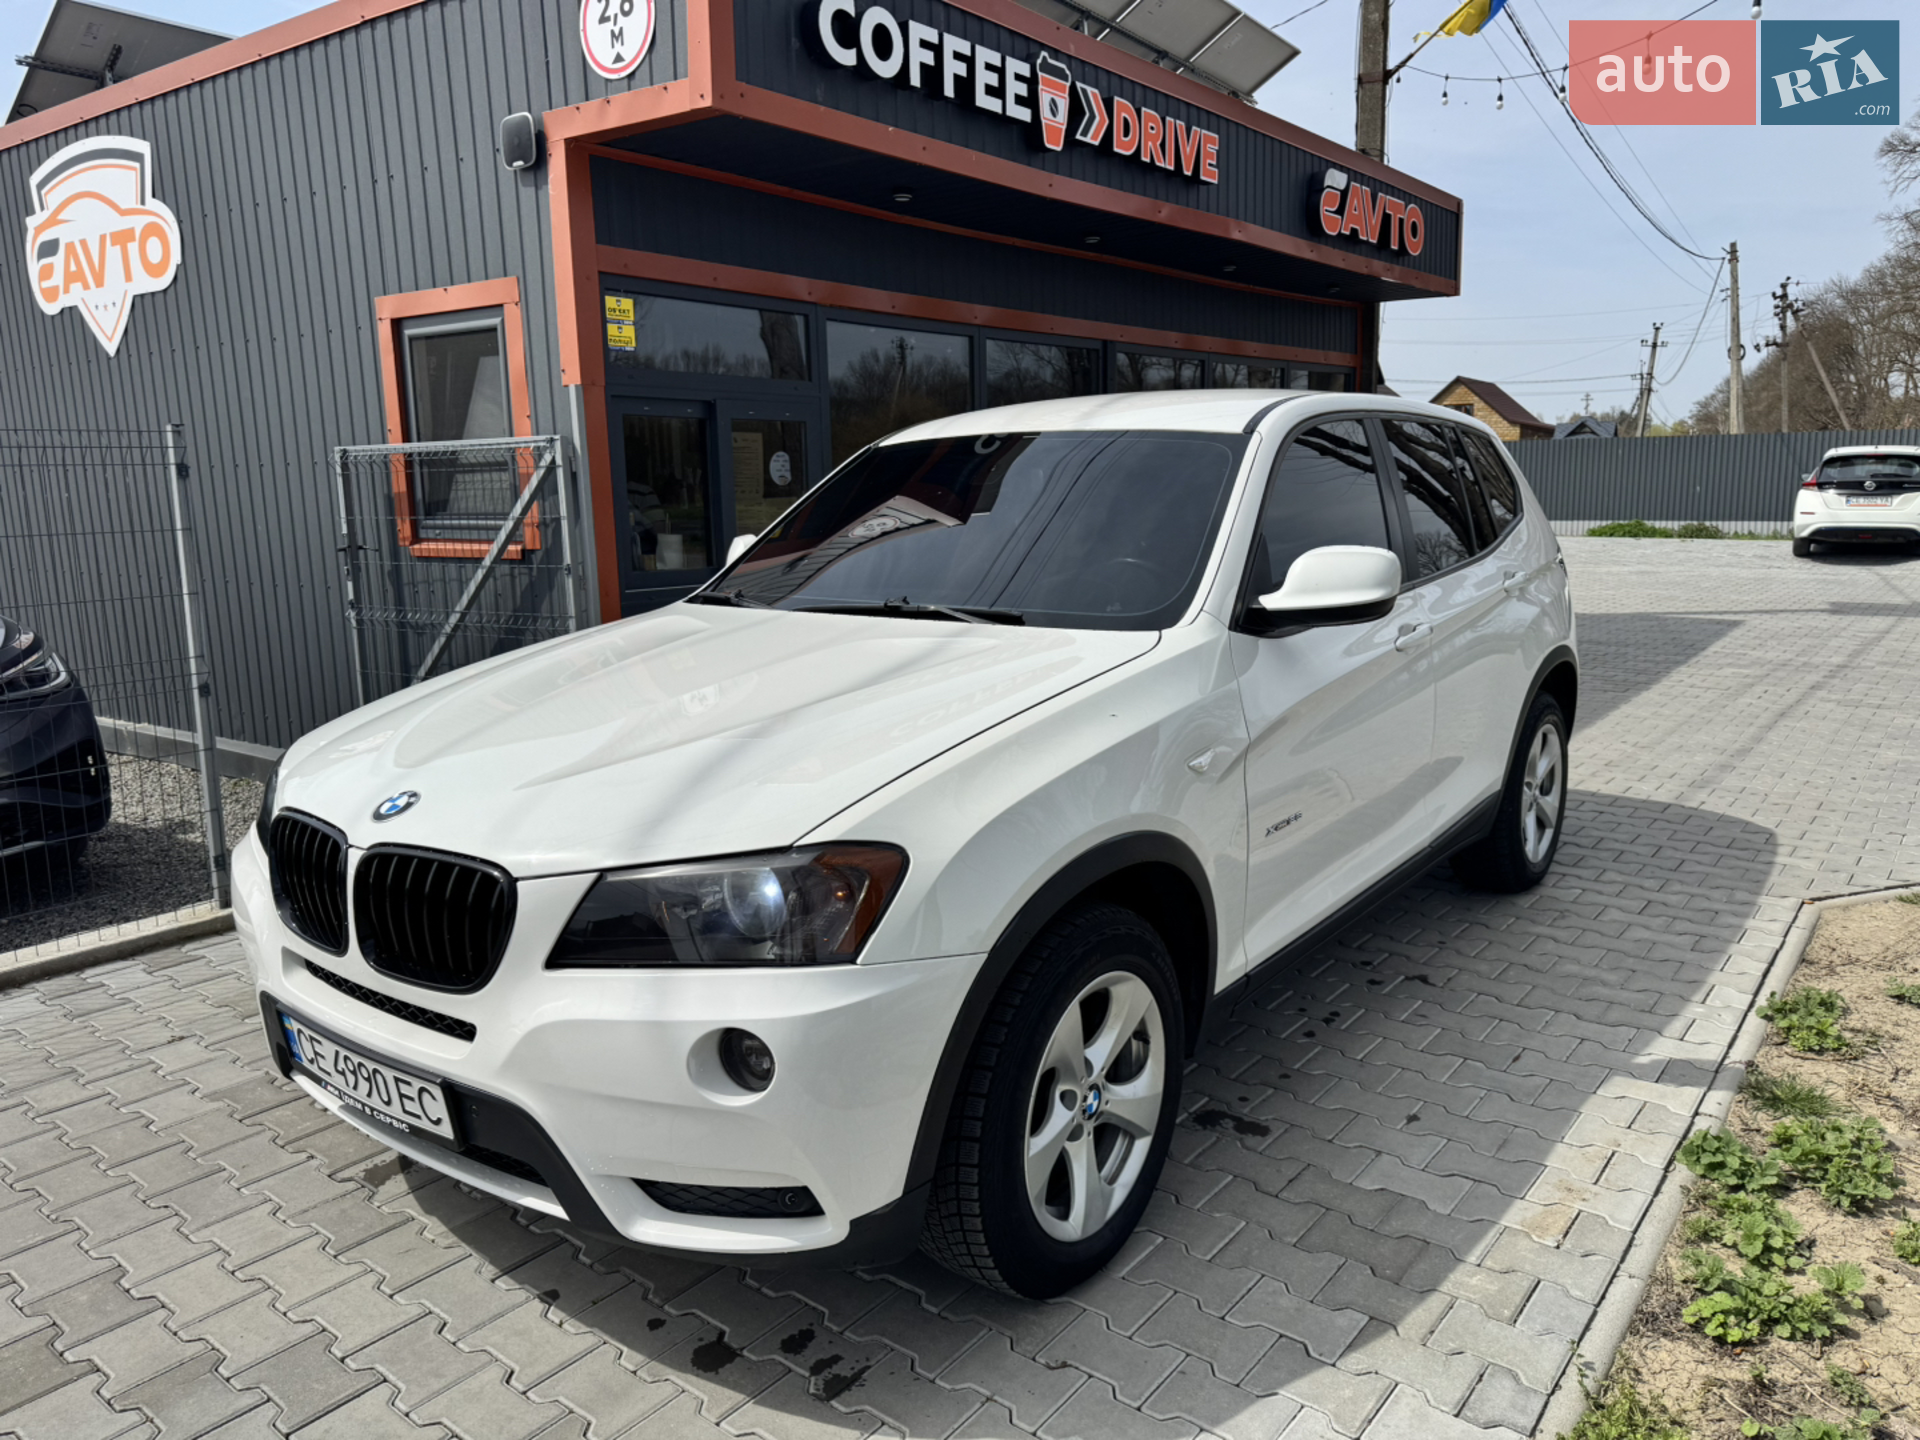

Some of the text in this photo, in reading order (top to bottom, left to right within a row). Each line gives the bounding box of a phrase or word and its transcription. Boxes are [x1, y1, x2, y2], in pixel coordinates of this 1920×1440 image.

[818, 0, 1219, 184] COFFEE DRIVE
[297, 1028, 443, 1126] CE 4990 EC
